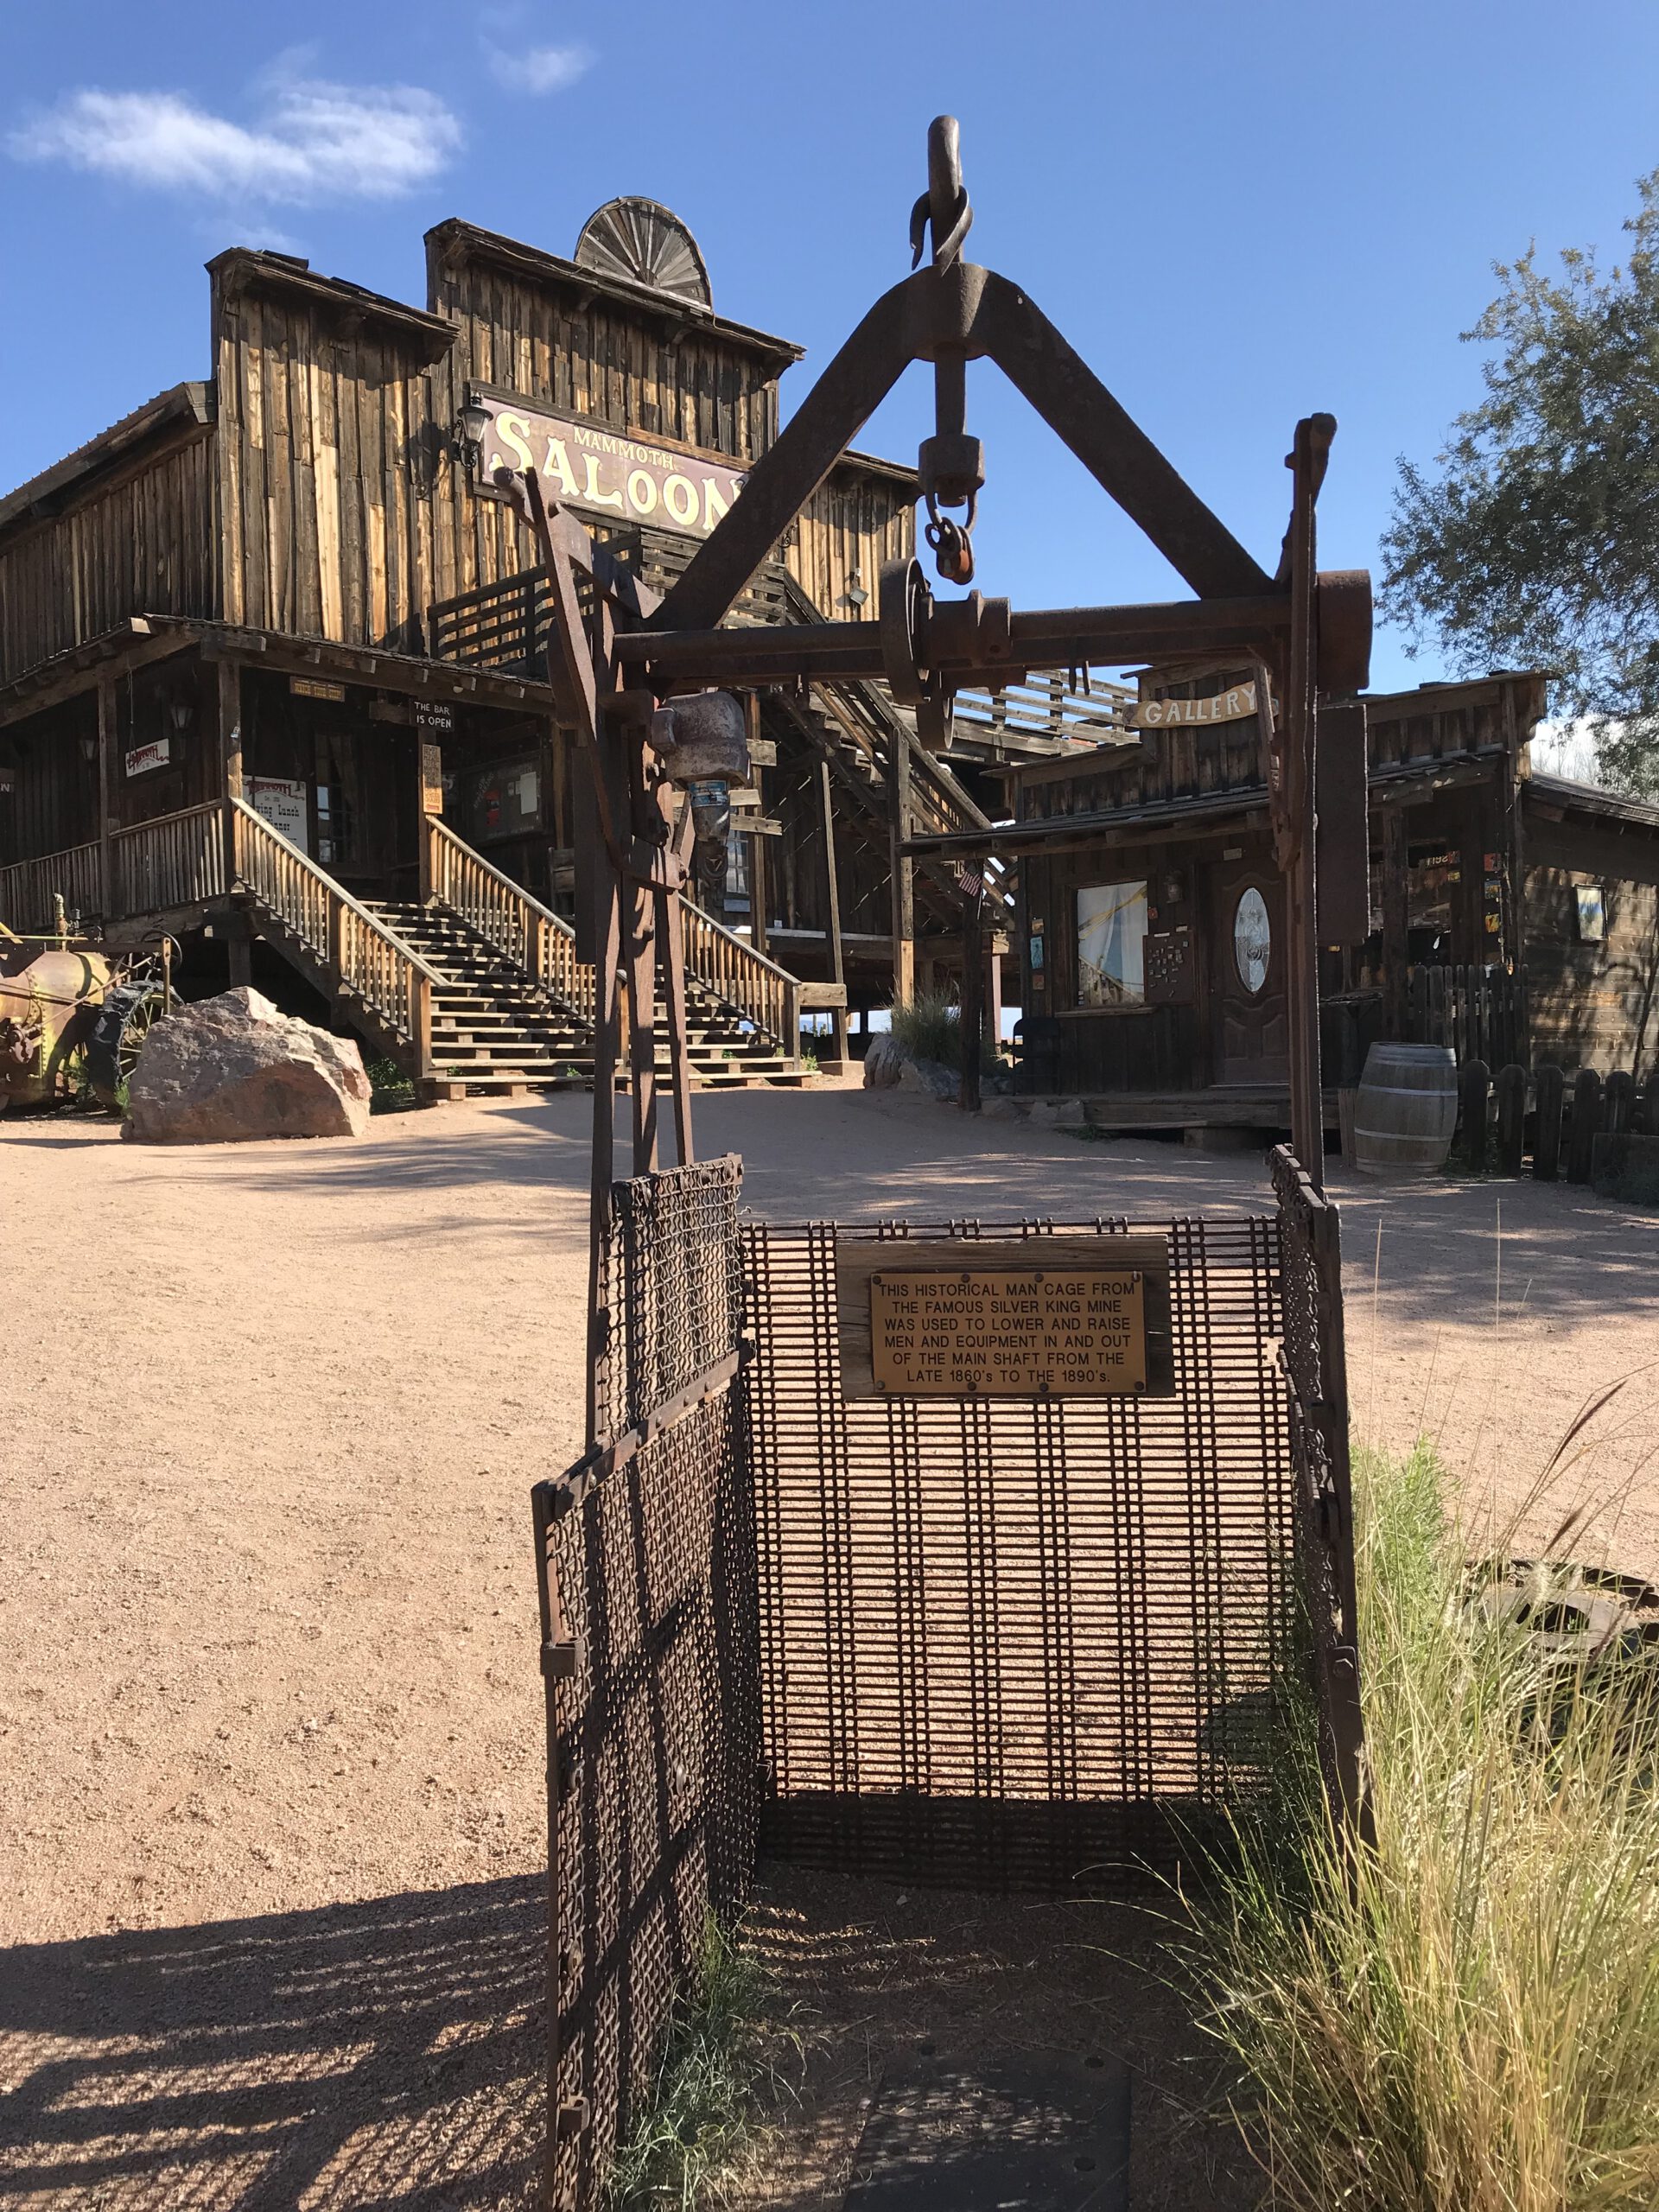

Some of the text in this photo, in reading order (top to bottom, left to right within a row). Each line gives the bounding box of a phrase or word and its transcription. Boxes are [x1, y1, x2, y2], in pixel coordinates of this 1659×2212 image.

[573, 425, 674, 471] MAMMOTH
[488, 410, 742, 532] SALOON
[414, 701, 450, 715] THE BAR
[1145, 683, 1256, 724] GALLERY
[416, 715, 451, 728] IS OPEN
[278, 804, 300, 817] Lunch
[879, 1281, 1135, 1297] THIS HISTORICAL MAN CAGE FROM
[892, 1300, 1122, 1313] THE FAMOUS SILVER KING MINE
[885, 1317, 1131, 1331] WAS USED TO LOWER AND RAISE
[885, 1335, 1131, 1348] MEN AND EQUIPMENT IN AND OUT
[893, 1352, 1124, 1365] OF THE MAIN SHAFT FROM THE
[906, 1370, 1110, 1382] LATE 1860's TO THE 1890's.
